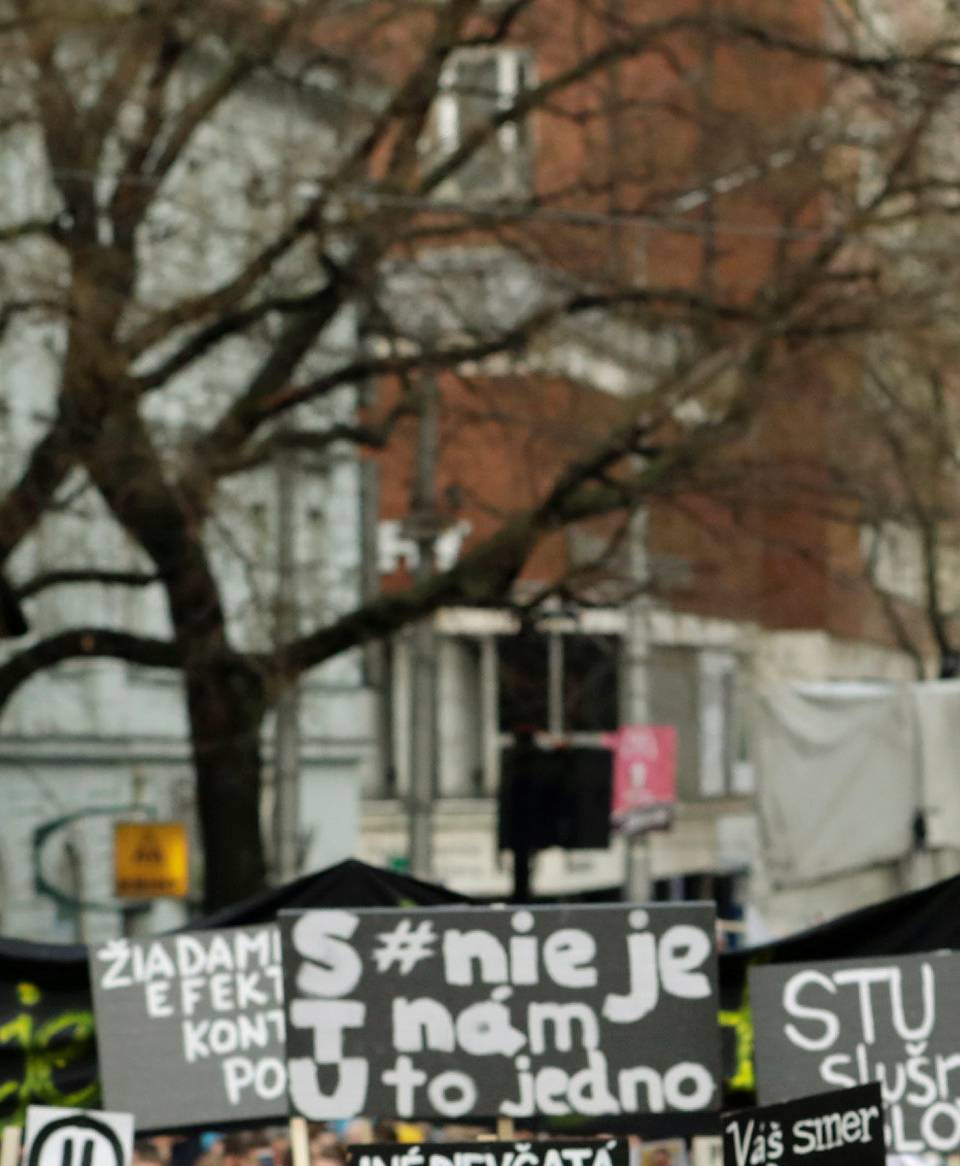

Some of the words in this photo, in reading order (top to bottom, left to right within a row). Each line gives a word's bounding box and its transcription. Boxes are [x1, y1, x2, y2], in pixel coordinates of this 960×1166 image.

[603, 909, 713, 1023] je
[392, 985, 601, 1057] nám
[782, 962, 937, 1051] STU
[381, 1055, 478, 1118] to
[500, 1049, 716, 1117] jedno
[793, 1106, 881, 1155] smer
